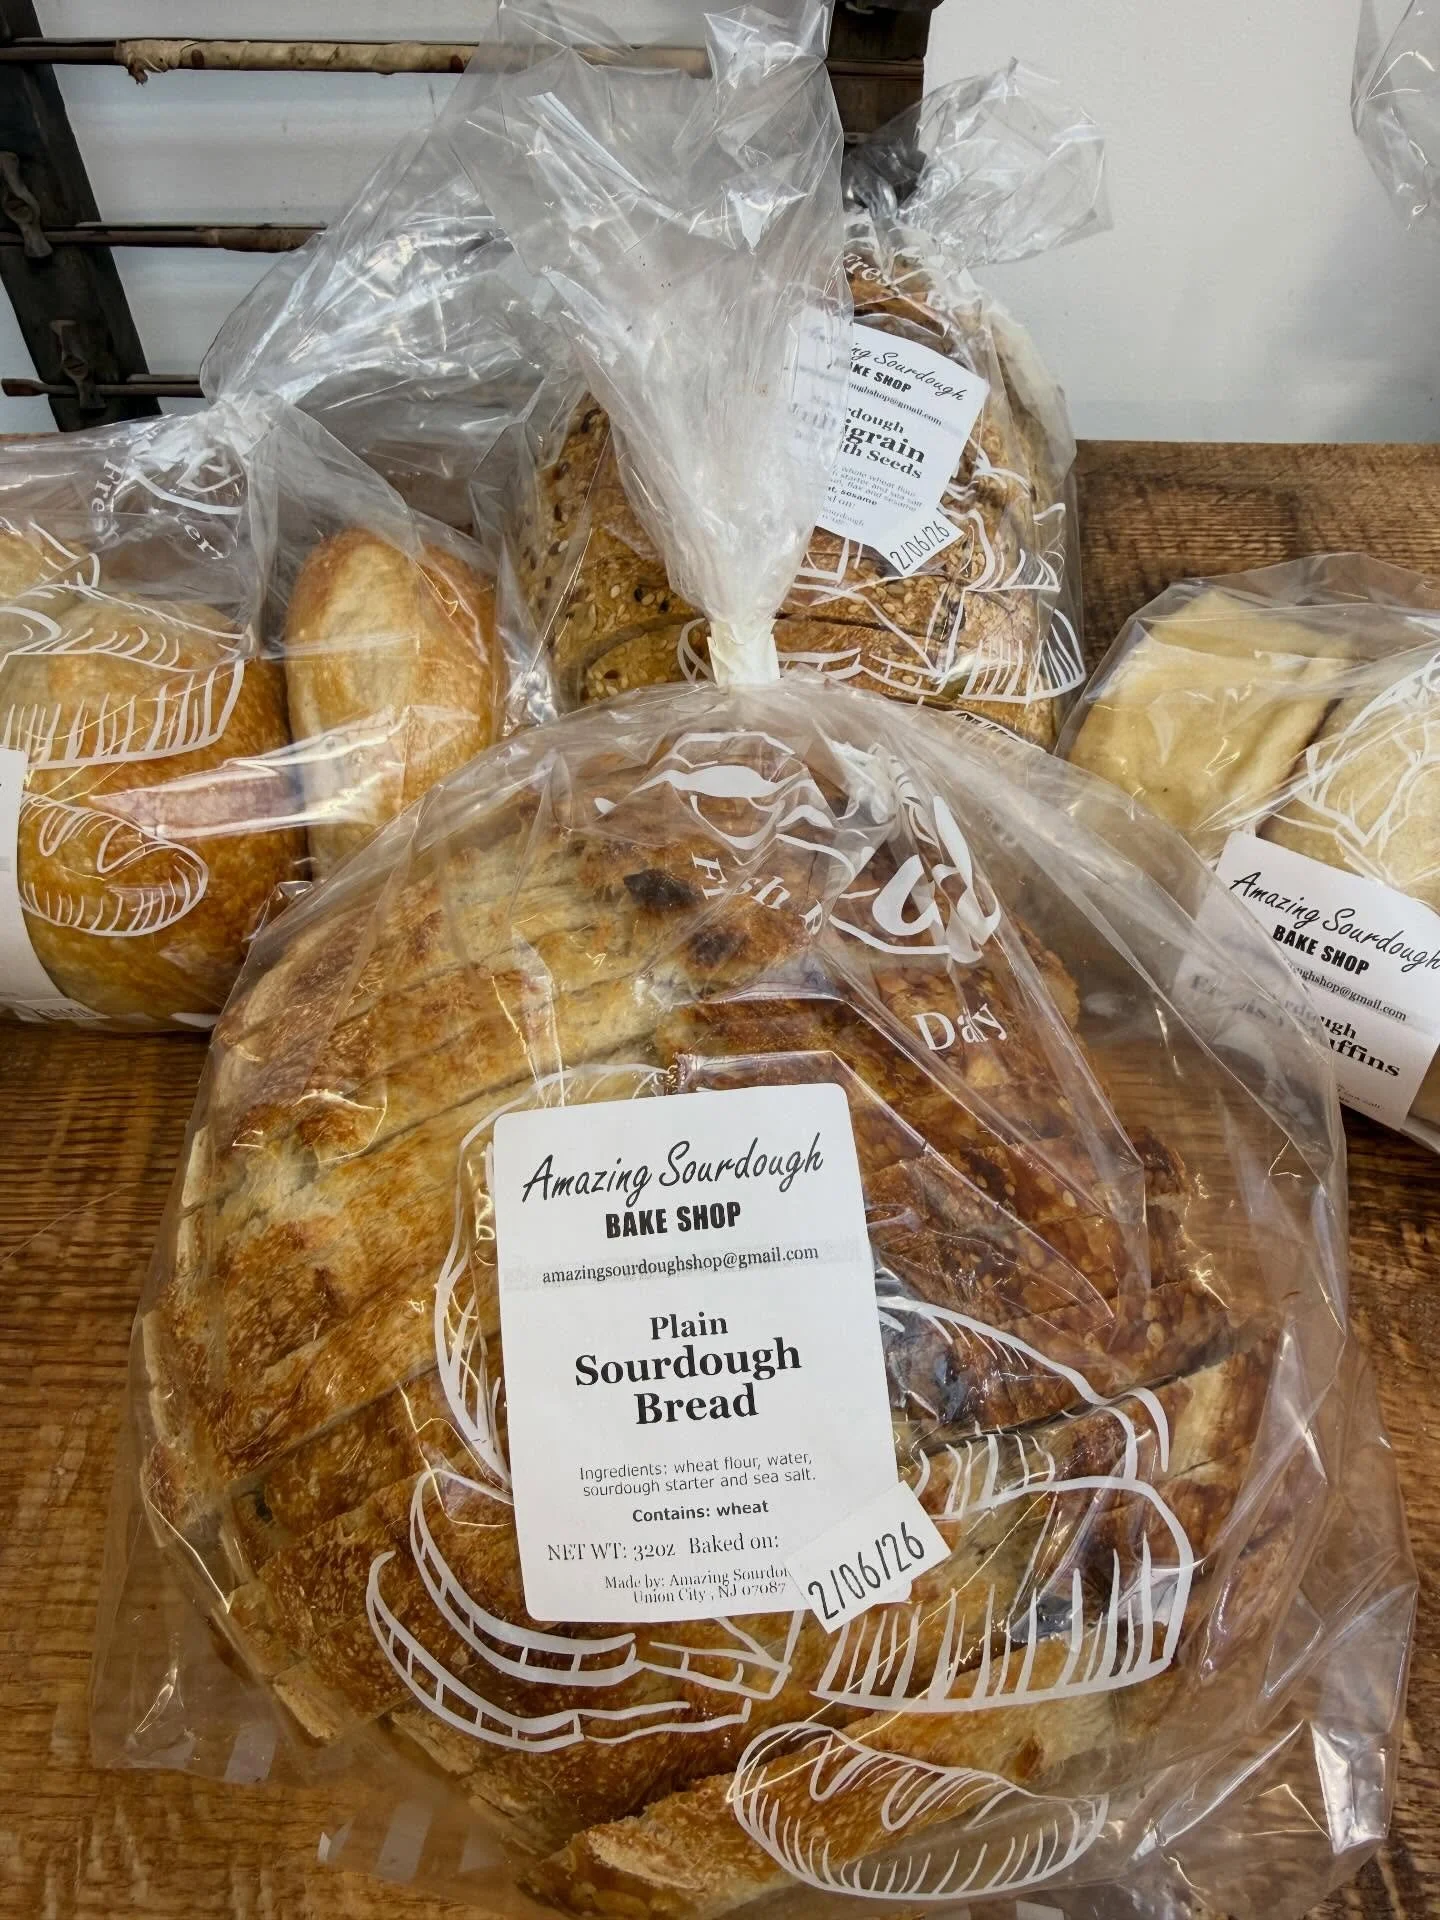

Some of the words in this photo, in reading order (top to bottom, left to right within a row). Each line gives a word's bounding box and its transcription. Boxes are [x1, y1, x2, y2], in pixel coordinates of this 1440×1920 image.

[873, 372, 912, 393] SHOP
[874, 352, 965, 401] Sourdough
[847, 406, 904, 434] dough
[844, 418, 925, 464] igrain
[866, 447, 923, 479] Seeds
[890, 521, 951, 571] 2/06/26
[1229, 870, 1320, 929] Amazing
[1322, 908, 1440, 973] Sourdough
[1272, 924, 1319, 956] BAKE
[1321, 945, 1370, 976] SHOP
[911, 1002, 1008, 1052] Day
[1329, 1038, 1400, 1078] ffins
[522, 1154, 652, 1206] Amazing
[659, 1132, 823, 1193] Sourdough
[605, 1209, 667, 1239] BAKE
[677, 1201, 741, 1231] SHOP
[542, 1246, 819, 1285] amazingsourdoughshop@gmail.com
[650, 1312, 728, 1340] Plain
[575, 1337, 801, 1387] Sourdough
[635, 1384, 758, 1424] Bread
[580, 1463, 668, 1481] Ingredients:
[675, 1458, 719, 1474] wheat
[725, 1456, 761, 1471] flour,
[767, 1452, 812, 1467] water,
[583, 1480, 660, 1497] sourdough
[666, 1477, 714, 1491] starter
[720, 1473, 748, 1487] and
[754, 1473, 779, 1484] sea
[785, 1468, 816, 1482] salt.
[632, 1506, 710, 1522] Contains:
[717, 1500, 769, 1517] wheat
[548, 1544, 585, 1560] NET
[591, 1542, 627, 1559] WT:
[634, 1543, 676, 1561] 32oz
[689, 1533, 744, 1554] Baked
[750, 1534, 779, 1549] on:
[605, 1574, 641, 1588] Made
[645, 1574, 664, 1588] by:
[670, 1571, 729, 1586] Amazing
[807, 1522, 925, 1620] 2/06/26
[633, 1588, 675, 1603] Union
[718, 1584, 737, 1597] NJ
[742, 1582, 786, 1595] 07087
